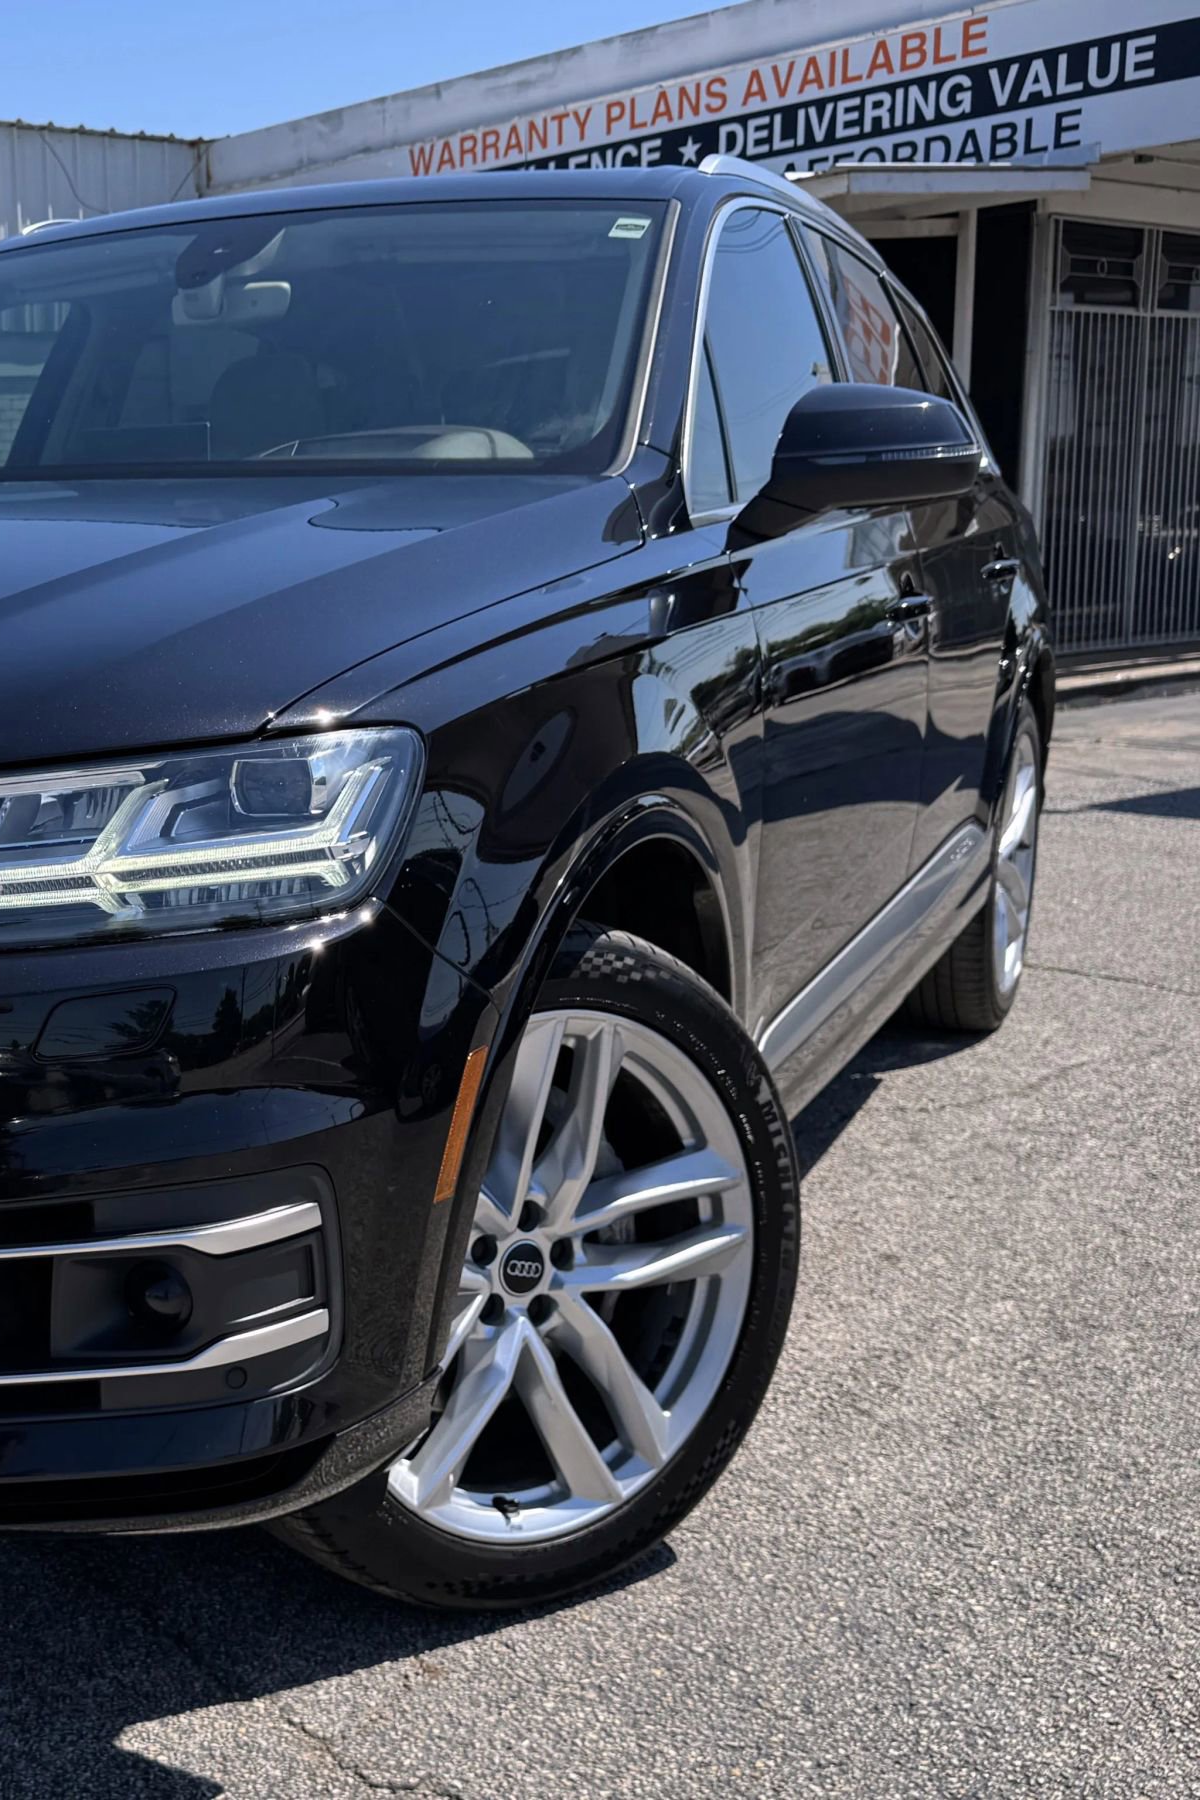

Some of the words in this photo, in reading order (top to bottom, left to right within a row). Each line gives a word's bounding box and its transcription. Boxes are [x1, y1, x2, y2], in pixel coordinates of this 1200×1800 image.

[408, 106, 593, 178] WARRANTY
[605, 76, 729, 136] PLANS
[741, 15, 990, 107] AVAILABLE
[718, 74, 973, 159] DELIVERING
[988, 34, 1157, 104] VALUE
[783, 108, 1083, 172] RDABLE
